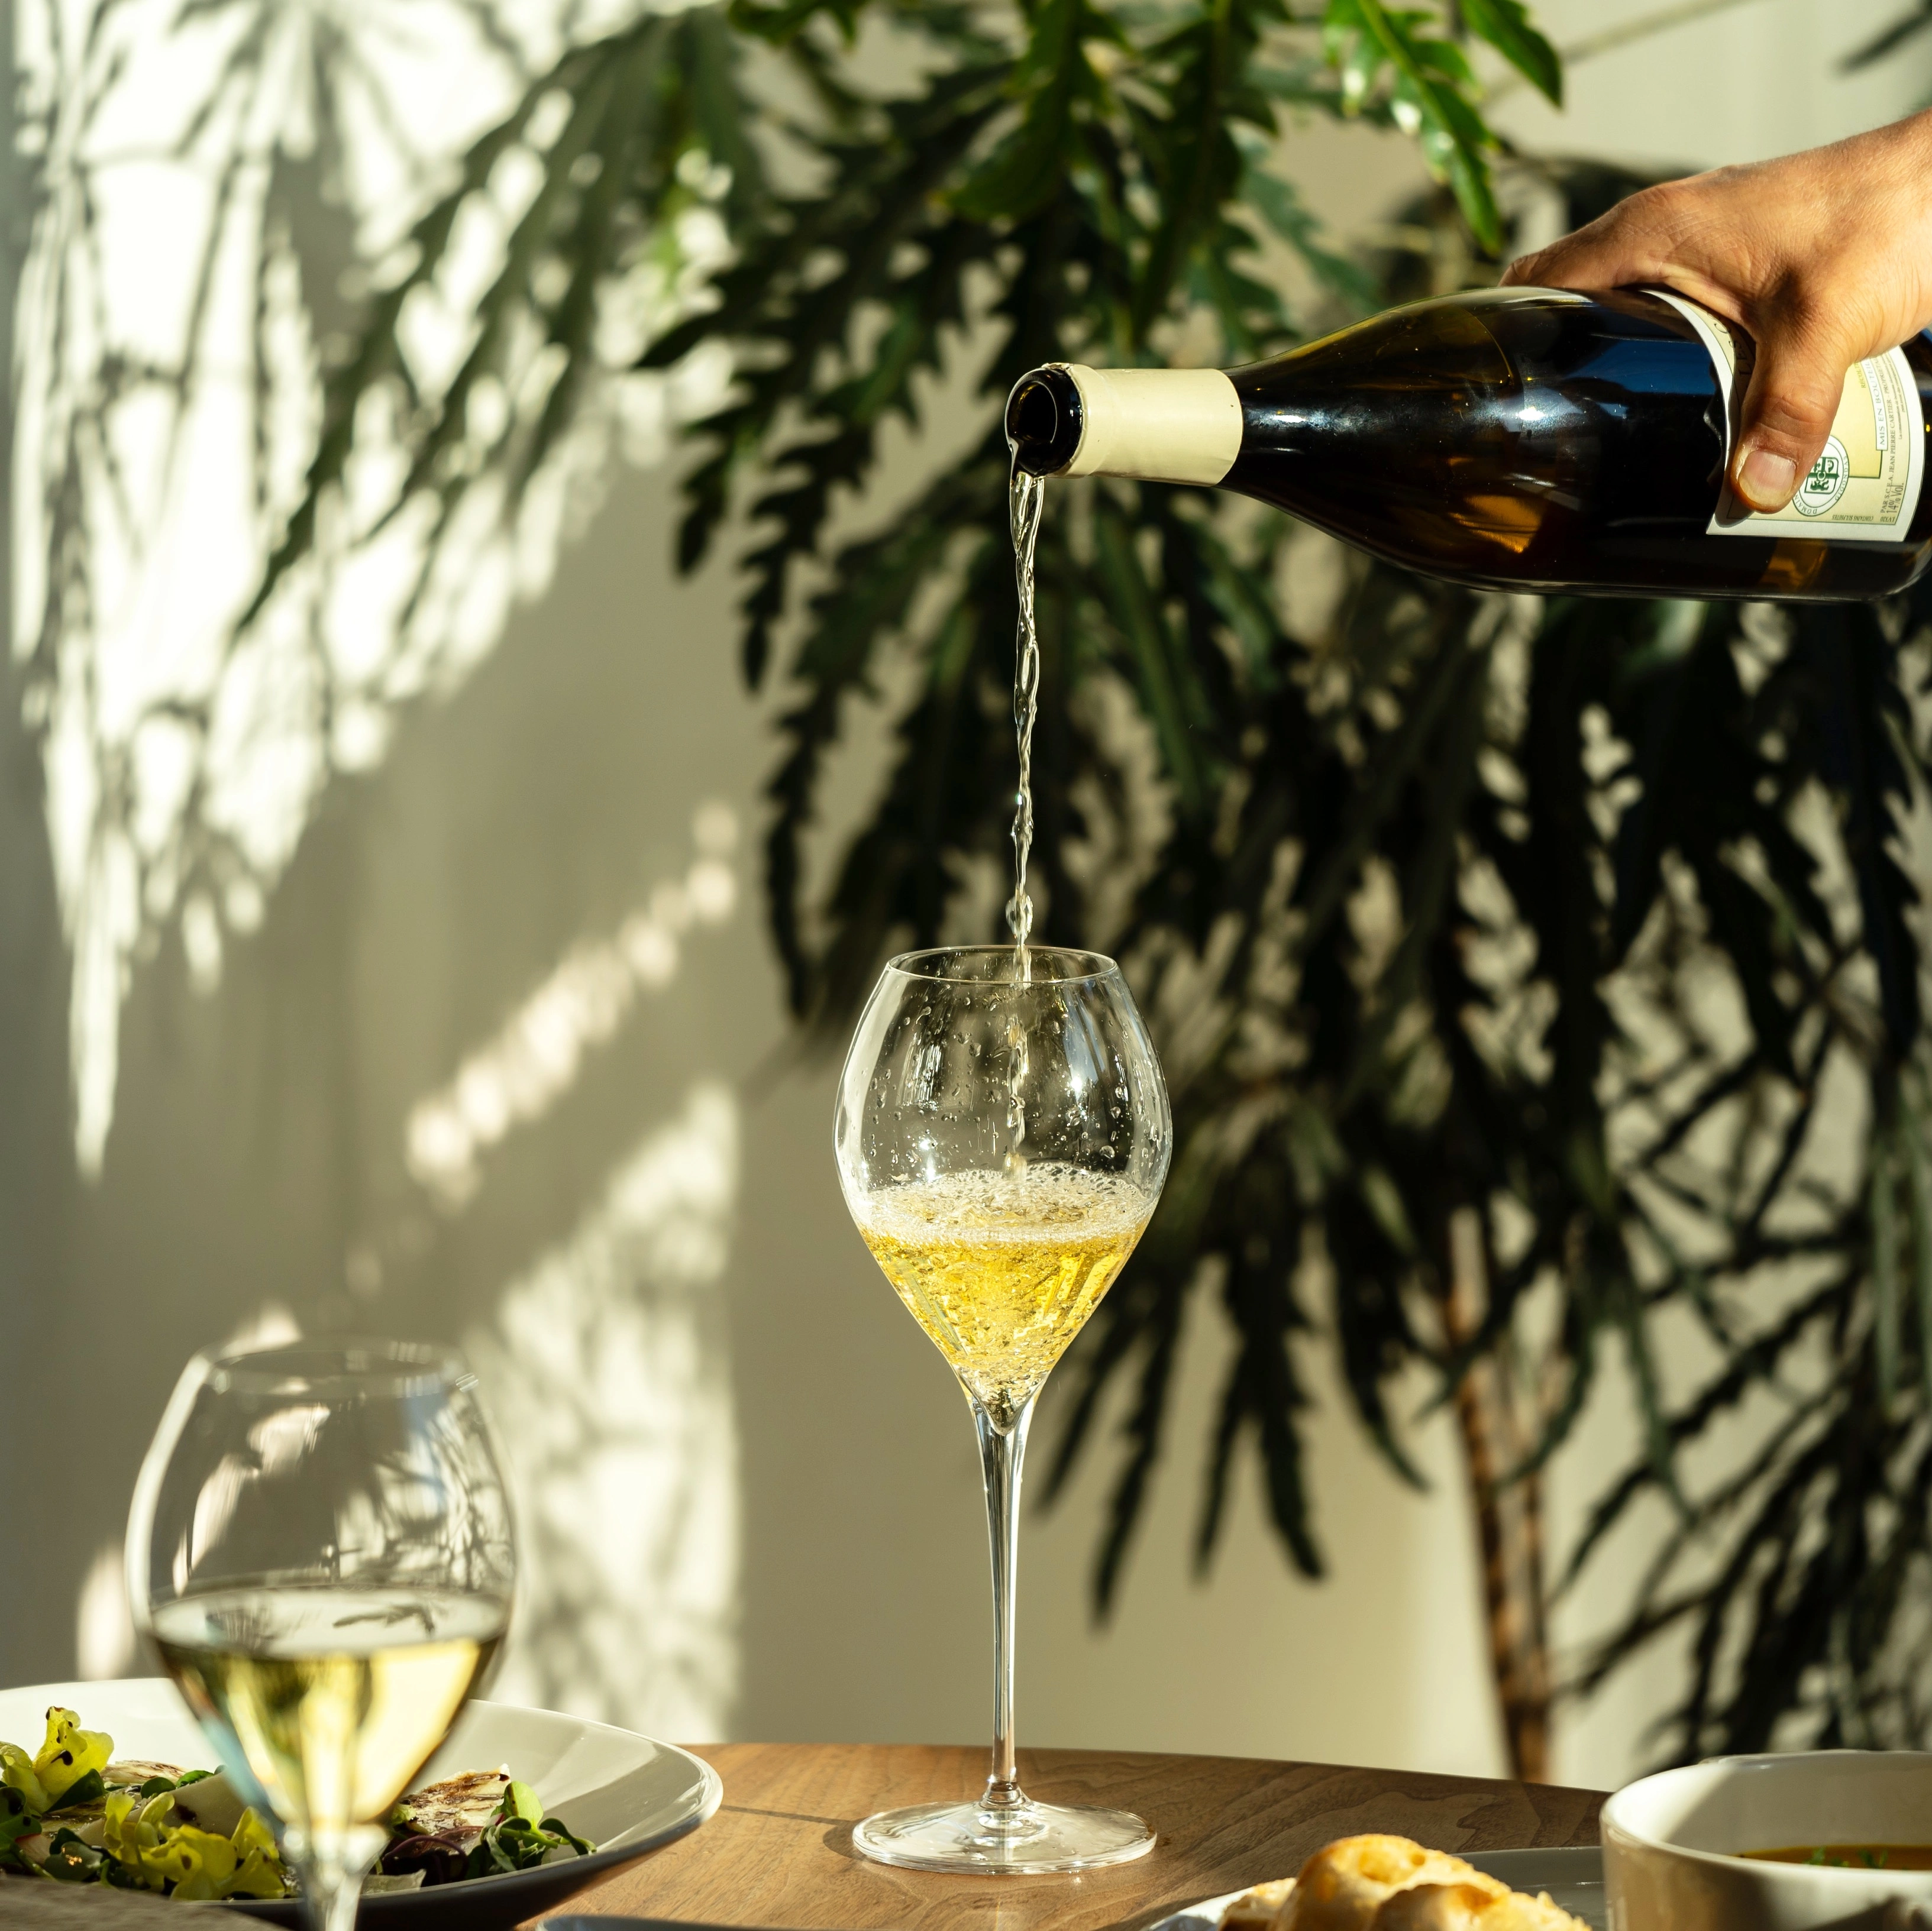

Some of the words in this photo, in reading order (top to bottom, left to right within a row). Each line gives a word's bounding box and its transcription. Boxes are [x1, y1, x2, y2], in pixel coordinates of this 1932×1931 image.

[1865, 362, 1881, 403] BOUTEIL
[1877, 408, 1884, 421] EN
[1834, 456, 1848, 501] GIGONDAS
[1794, 494, 1817, 514] DOMAIN
